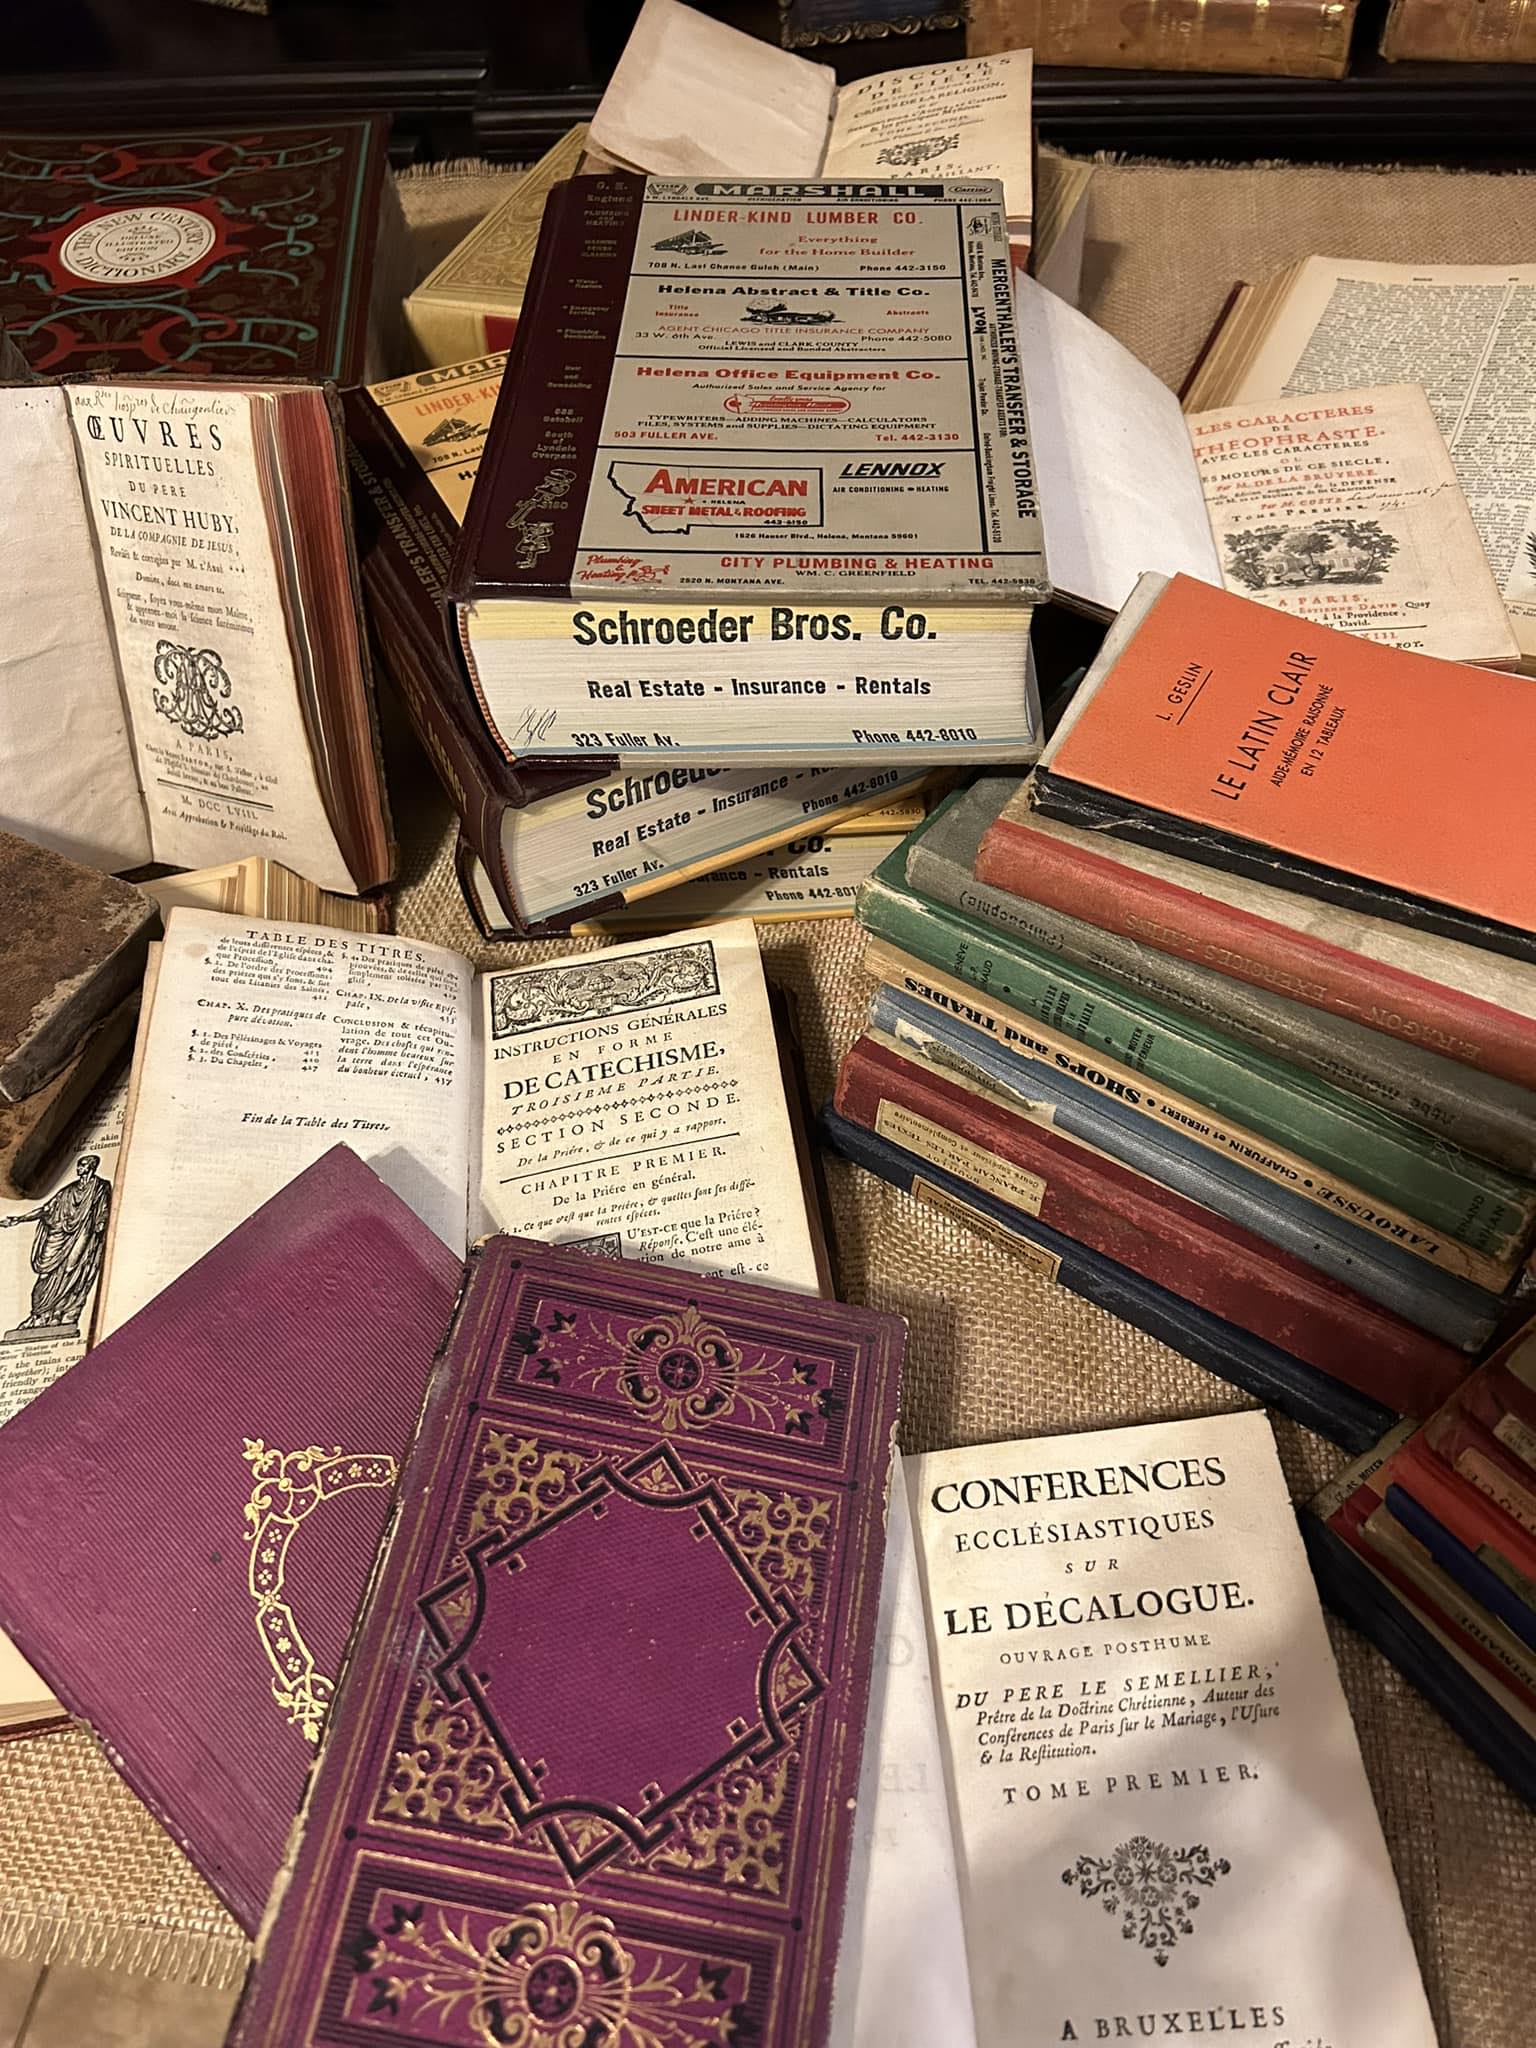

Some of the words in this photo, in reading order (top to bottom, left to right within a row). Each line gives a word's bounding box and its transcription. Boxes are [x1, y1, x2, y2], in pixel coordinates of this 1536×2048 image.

[713, 185, 925, 198] MARSHALL
[73, 231, 95, 253] THE
[98, 212, 143, 233] NEW
[150, 210, 204, 246] CENTURY
[673, 208, 792, 225] LINDER-KIND
[806, 211, 879, 225] LUMBER
[893, 212, 924, 225] CO.
[759, 247, 780, 256] for
[784, 248, 806, 256] the
[810, 248, 855, 256] Home
[860, 248, 915, 257] Builder
[799, 235, 878, 245] Everything
[75, 251, 191, 278] DICTIONARY
[658, 284, 727, 296] Helena
[731, 285, 818, 297] Abstract
[825, 286, 841, 297] &
[846, 286, 891, 297] Title
[896, 287, 930, 298] Co.
[971, 306, 988, 334] LYON
[991, 259, 1018, 365] MERGENTHALER'S
[658, 325, 699, 334] AGENT
[702, 326, 760, 334] CHICAGO
[764, 327, 791, 335] TITLE
[795, 327, 863, 335] INSURANCE
[868, 327, 930, 336] COMPANY
[861, 335, 895, 344] Phone
[898, 334, 953, 343] 442-5080
[637, 366, 710, 379] Helena
[715, 368, 779, 380] Office
[785, 369, 900, 382] Equipment
[905, 370, 941, 380] Co.
[1003, 366, 1026, 435] TRANSFER
[87, 414, 222, 451] ŒUVRES
[614, 431, 636, 440] 503
[640, 431, 687, 440] FULLER
[691, 432, 718, 440] AVE.
[1194, 422, 1232, 437] LES
[1237, 404, 1375, 430] CARACTERES
[1272, 425, 1291, 433] DE
[876, 434, 897, 442] Tel.
[901, 433, 959, 442] 442-3130
[1010, 438, 1027, 448] &
[1201, 452, 1239, 465] AVEC
[1243, 448, 1270, 459] LES
[1273, 440, 1370, 456] CARACTERES
[104, 451, 215, 477] SPIRITUELLES
[840, 462, 946, 478] LENNOX
[1284, 464, 1303, 473] DE
[1307, 461, 1327, 471] CE
[1330, 457, 1391, 468] SIECLE.
[128, 480, 146, 494] DU
[153, 483, 187, 498] PERE
[644, 468, 808, 497] AMERICAN
[1011, 451, 1037, 519] STORAGE
[101, 499, 178, 526] VINCENT
[182, 510, 240, 535] HUBY,
[641, 504, 686, 516] SHEET
[688, 505, 734, 517] METAL
[743, 507, 807, 518] ROOFING
[720, 556, 765, 569] CITY
[772, 557, 877, 569] PLUMBING
[884, 557, 899, 569] &
[904, 557, 994, 569] HEATING
[838, 570, 917, 578] GREENFIELD
[1405, 600, 1431, 610] Quay
[571, 610, 754, 646] Schroeder
[771, 606, 862, 642] Bros.
[880, 605, 938, 641] Co.
[587, 680, 632, 699] Real
[639, 679, 706, 698] Estate
[732, 677, 826, 696] Insurance
[855, 675, 932, 695] Rentals
[1156, 711, 1173, 722] L.
[1167, 662, 1204, 705] GESLIN
[1267, 651, 1318, 706] CLAIR
[571, 733, 602, 747] 323
[607, 733, 650, 748] Fuller
[655, 733, 681, 747] Av.
[853, 729, 900, 744] Phone
[906, 728, 978, 743] 442-8010
[1227, 709, 1284, 773] LATIN
[1270, 727, 1310, 788] AIDE-MÉMOIRE
[1302, 684, 1334, 727] RAISONNÉ
[1300, 764, 1313, 777] EN
[1308, 747, 1324, 760] 12
[1316, 706, 1347, 747] TABLEAUX
[802, 795, 840, 815] Phone
[843, 770, 899, 799] 442-8010
[1210, 773, 1247, 801] LE
[593, 834, 631, 858] Real
[637, 810, 692, 842] Estate
[712, 775, 789, 814] Insurance
[573, 880, 600, 898] 323
[603, 867, 639, 888] Fuller
[642, 858, 665, 875] Av.
[768, 864, 830, 881] Rentals
[766, 889, 804, 902] Phone
[246, 930, 308, 946] TABLE
[314, 937, 349, 950] DES
[356, 942, 427, 963] TITRES.
[904, 976, 998, 1040] TRADES
[493, 1024, 619, 1060] INSTRUCTIONS
[627, 1004, 728, 1032] GÉNÉRALES
[553, 1050, 581, 1064] EN
[598, 1031, 674, 1055] FORME
[1004, 1027, 1049, 1056] and
[504, 1077, 541, 1100] DE
[544, 1040, 726, 1091] CATECHISME,
[1055, 1052, 1142, 1105] SHOPS
[511, 1082, 627, 1116] TROISIEME
[638, 1065, 721, 1088] PARTIE.
[497, 1119, 605, 1154] SECTION
[620, 1092, 741, 1126] SECONDE.
[1161, 1104, 1210, 1136] HERBERT
[1213, 1131, 1227, 1141] et
[520, 1165, 620, 1195] CHAPITRE
[633, 1145, 727, 1172] PREMIER.
[1229, 1139, 1298, 1180] CHAFFURIN
[1316, 1186, 1441, 1255] LAROUSSE
[931, 1456, 1227, 1515] CONFERENCES
[955, 1509, 1215, 1553] ECCLÉSIASTIQUES
[1065, 1557, 1120, 1575] SUR
[944, 1606, 992, 1636] LE
[1005, 1582, 1255, 1630] DÉCALOGUE.
[1000, 1646, 1093, 1665] OUVRAGE
[1104, 1634, 1212, 1657] POSTHUME
[955, 1691, 989, 1709] DU
[1003, 1683, 1065, 1703] PERE
[1081, 1680, 1108, 1697] LE
[975, 1709, 1016, 1726] Prêtre
[1020, 1706, 1035, 1721] de
[1039, 1705, 1053, 1720] la
[1057, 1701, 1114, 1719] Doctrine
[1203, 1688, 1249, 1705] Auteur
[1254, 1684, 1275, 1699] des
[978, 1726, 1054, 1748] Conférences
[1059, 1722, 1074, 1737] de
[1079, 1719, 1115, 1737] Paris
[1145, 1715, 1156, 1731] le
[1003, 1780, 1091, 1804] TOME
[1106, 1763, 1260, 1794] PREMIER.
[1061, 2019, 1079, 2041] A
[1095, 2004, 1287, 2039] BRUXELLES
